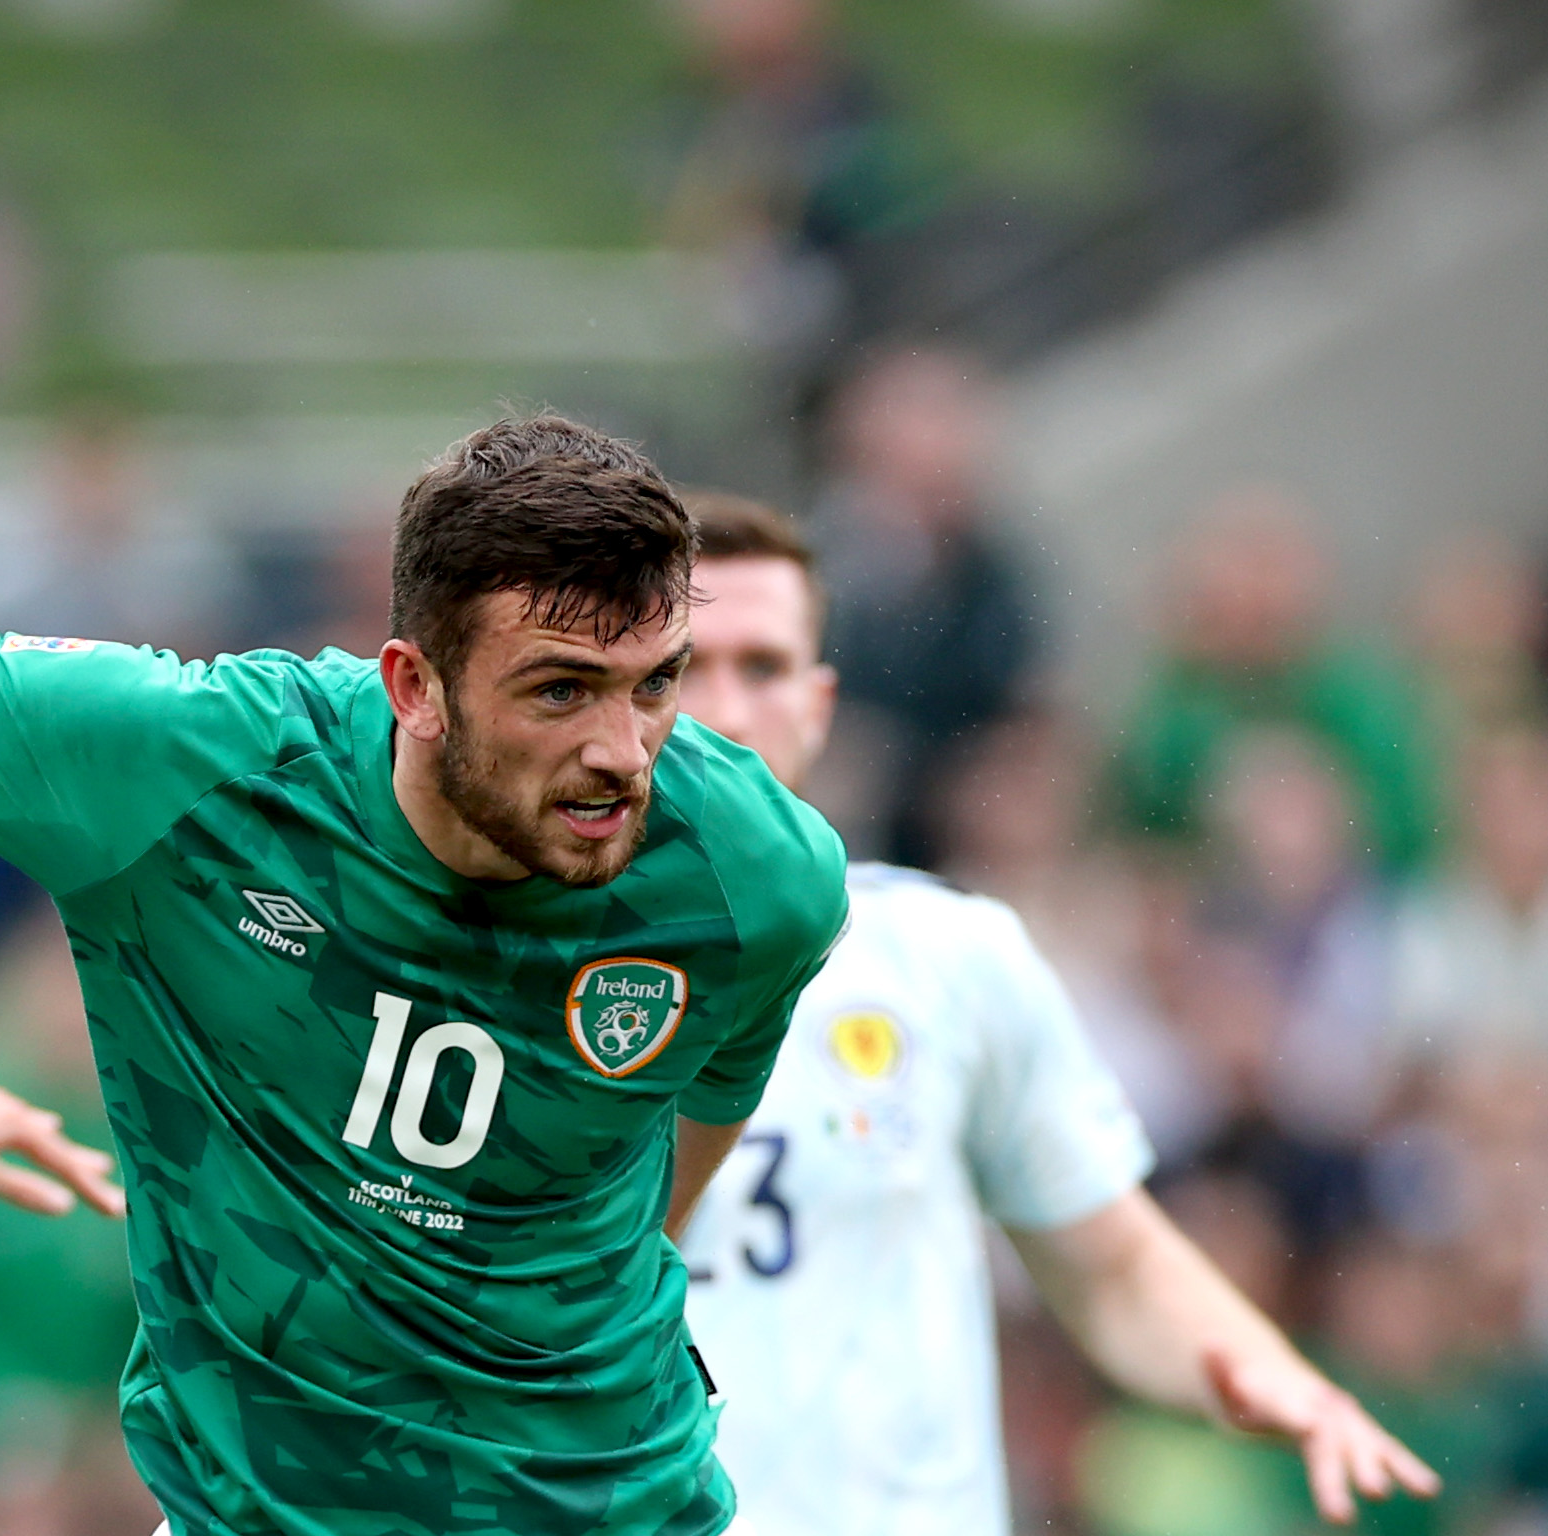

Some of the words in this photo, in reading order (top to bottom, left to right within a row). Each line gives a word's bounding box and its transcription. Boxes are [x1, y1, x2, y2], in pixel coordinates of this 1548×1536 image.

[238, 917, 306, 957] umbro
[596, 974, 667, 1000] Ireland
[342, 991, 505, 1169] 10
[360, 1180, 453, 1210] SCOTLAND
[400, 1174, 414, 1189] V
[348, 1187, 378, 1209] 11TH
[424, 1212, 465, 1231] 2022
[687, 1131, 795, 1278] 3
